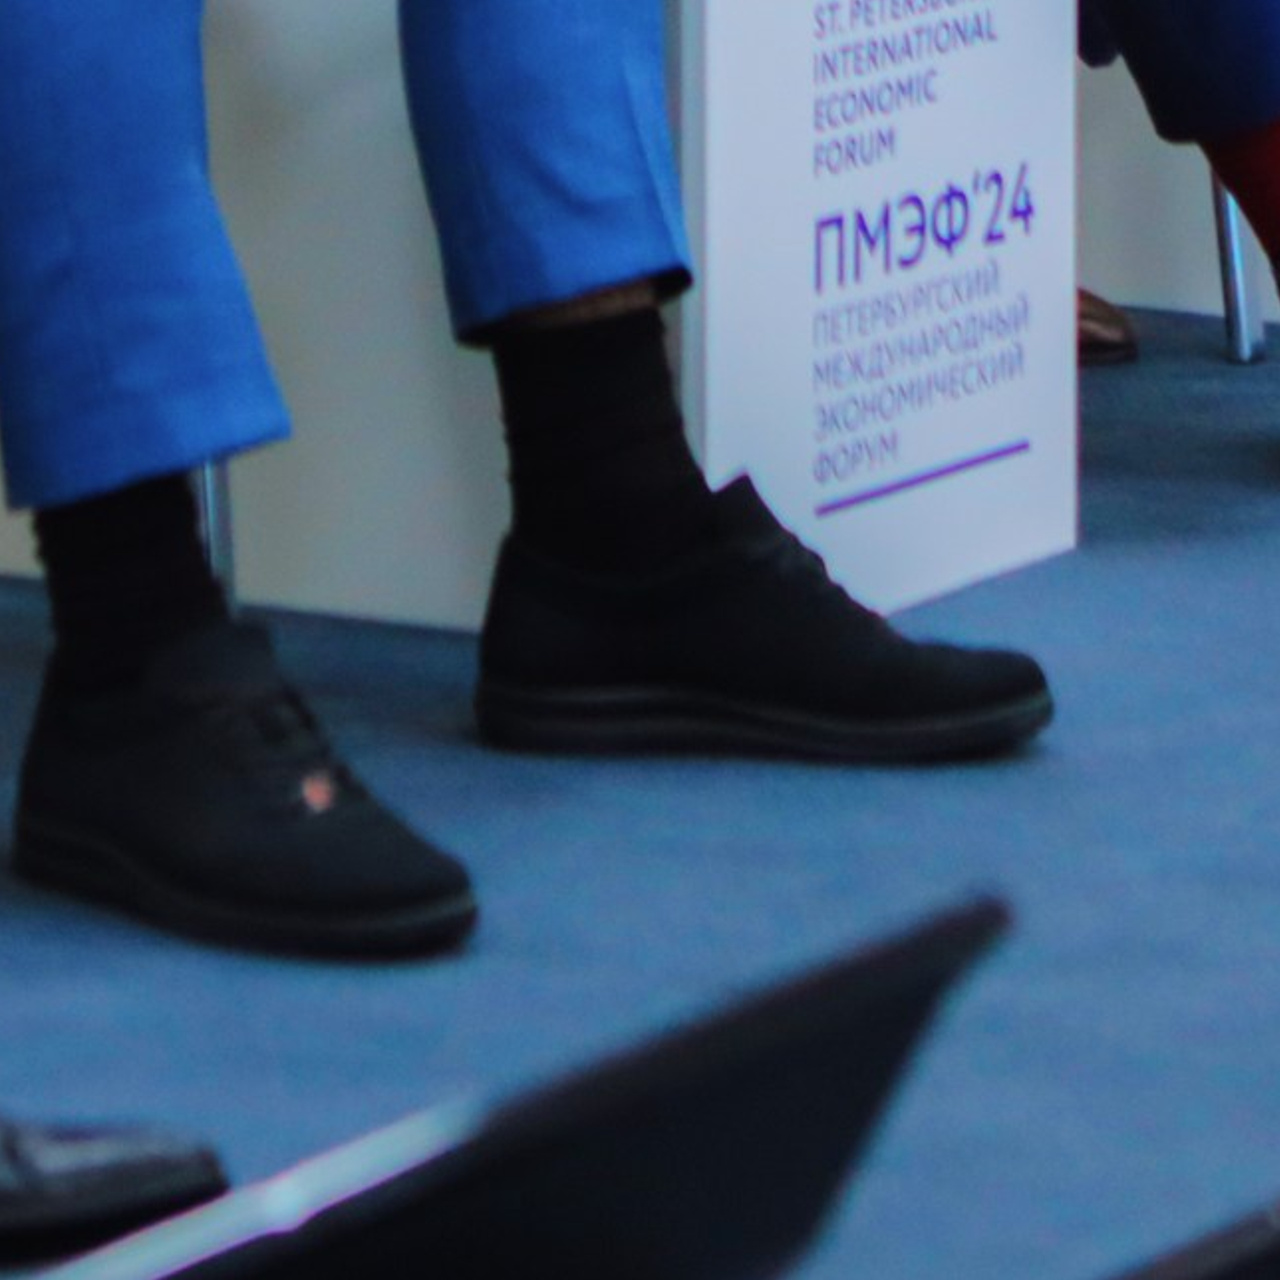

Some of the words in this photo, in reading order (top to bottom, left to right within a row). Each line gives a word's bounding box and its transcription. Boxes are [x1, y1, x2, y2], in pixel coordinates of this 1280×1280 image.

[813, 9, 998, 84] INTERNATIONAL
[814, 0, 842, 39] ST.
[813, 69, 938, 133] ECONOMIC
[813, 126, 896, 179] FORUM
[815, 162, 1034, 294] ПМЭФ'24
[813, 257, 1000, 348] ПЕТЕРБУРГСКИЙ
[813, 290, 1031, 392] МЕЖДУНАРОДНЫЙ
[813, 340, 1025, 443] ЭКОНОМИЧЕСКИЙ
[813, 428, 898, 485] ФОРУМ
